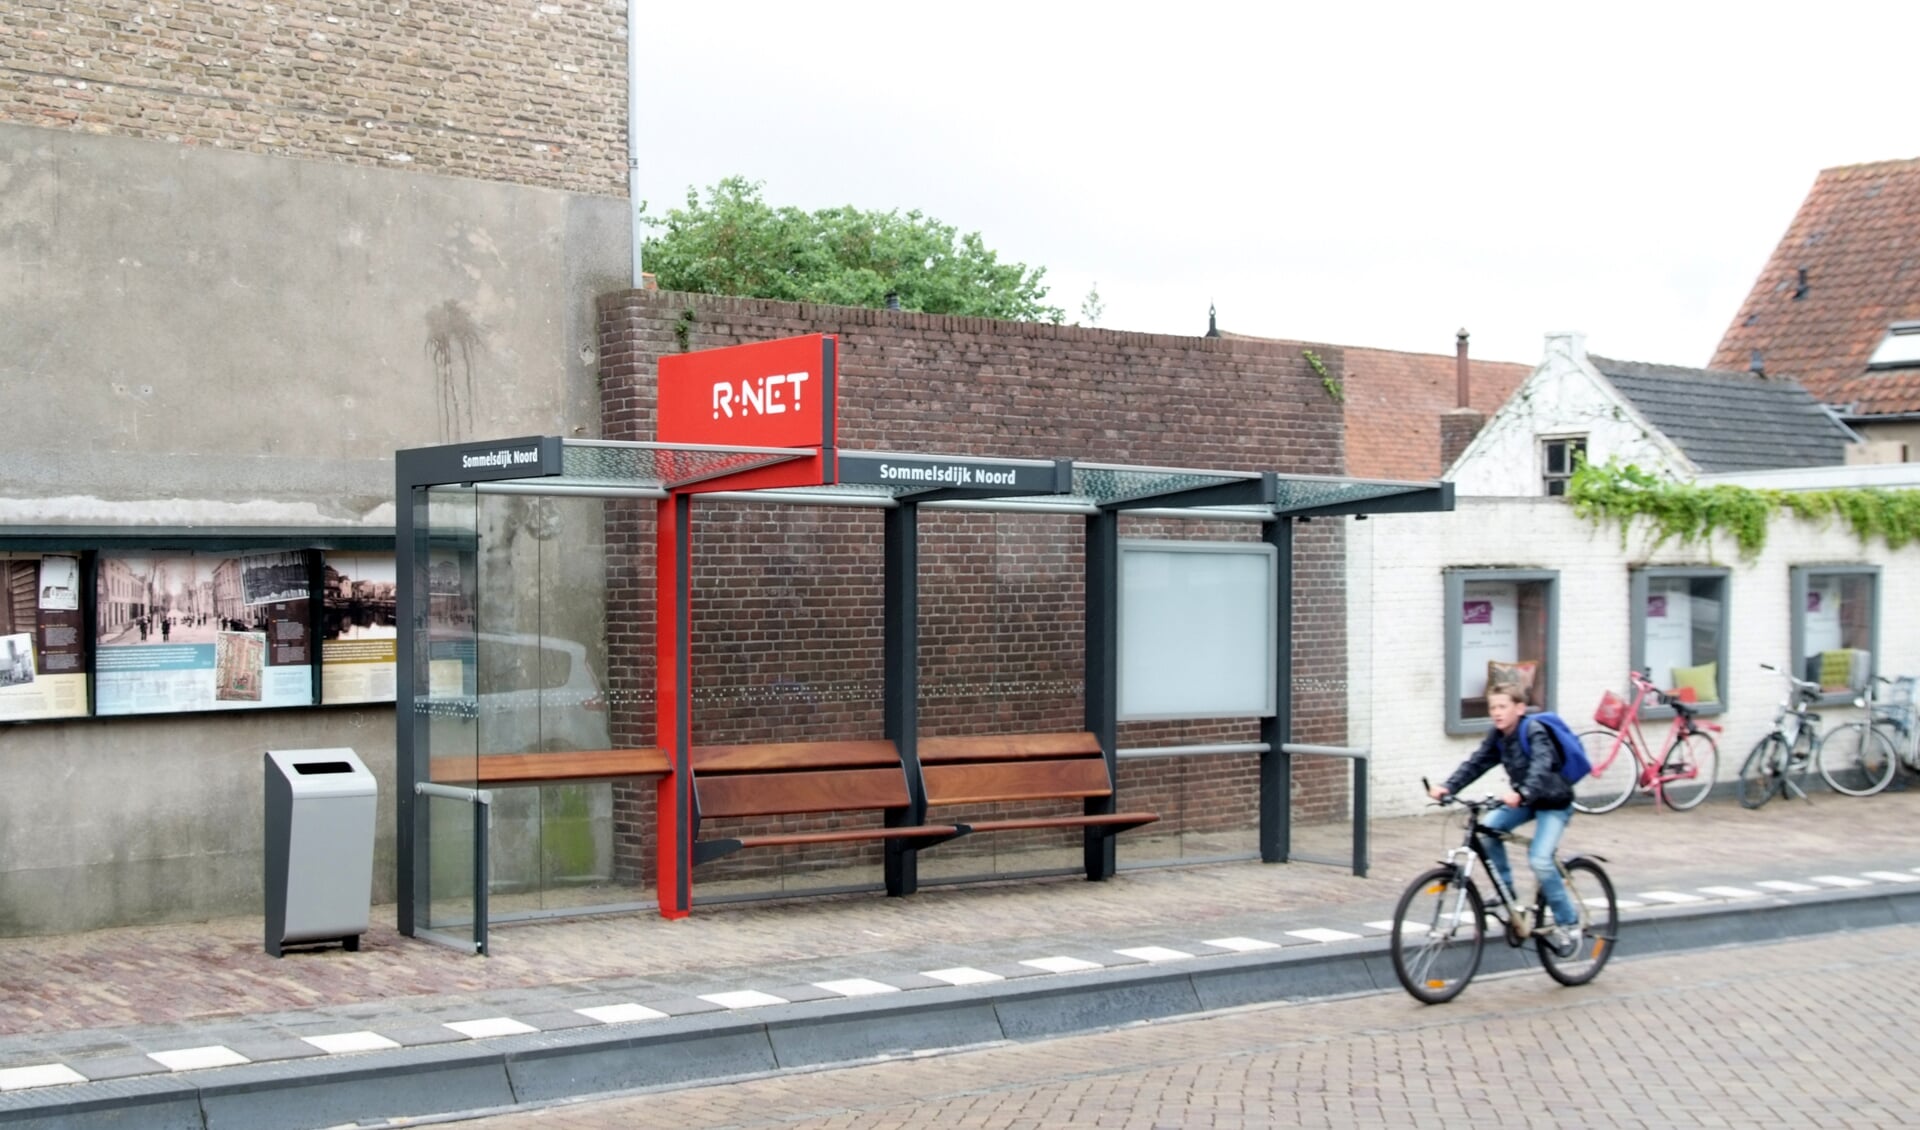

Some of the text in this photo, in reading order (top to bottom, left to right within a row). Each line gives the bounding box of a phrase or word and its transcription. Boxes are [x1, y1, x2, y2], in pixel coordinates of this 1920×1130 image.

[463, 447, 538, 468] Sommelsdijk Noord
[880, 464, 1016, 485] Sommelsdijk Noord
